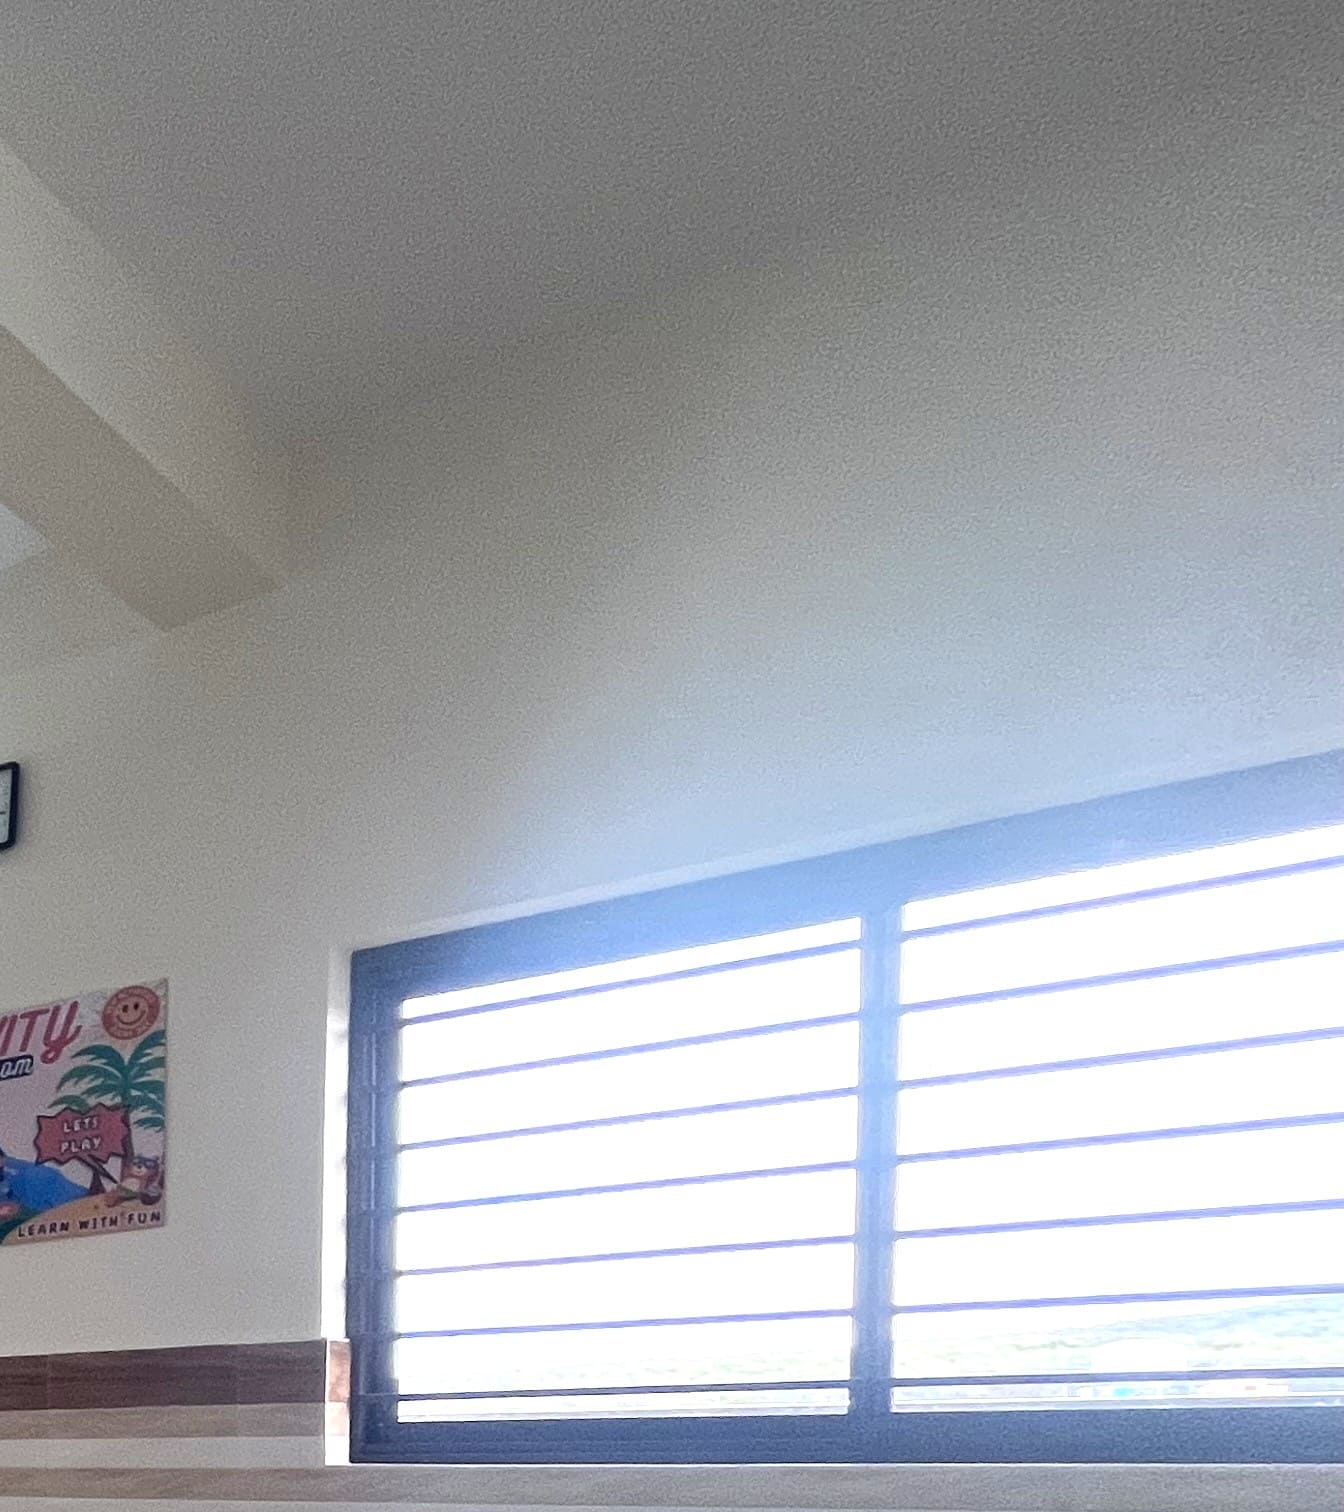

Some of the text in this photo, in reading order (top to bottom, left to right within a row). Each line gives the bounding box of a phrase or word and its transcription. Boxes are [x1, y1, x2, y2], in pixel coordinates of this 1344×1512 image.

[63, 1116, 99, 1133] LETS
[60, 1136, 102, 1154] PLAY
[17, 1211, 161, 1238] LEARN WITH FUN
